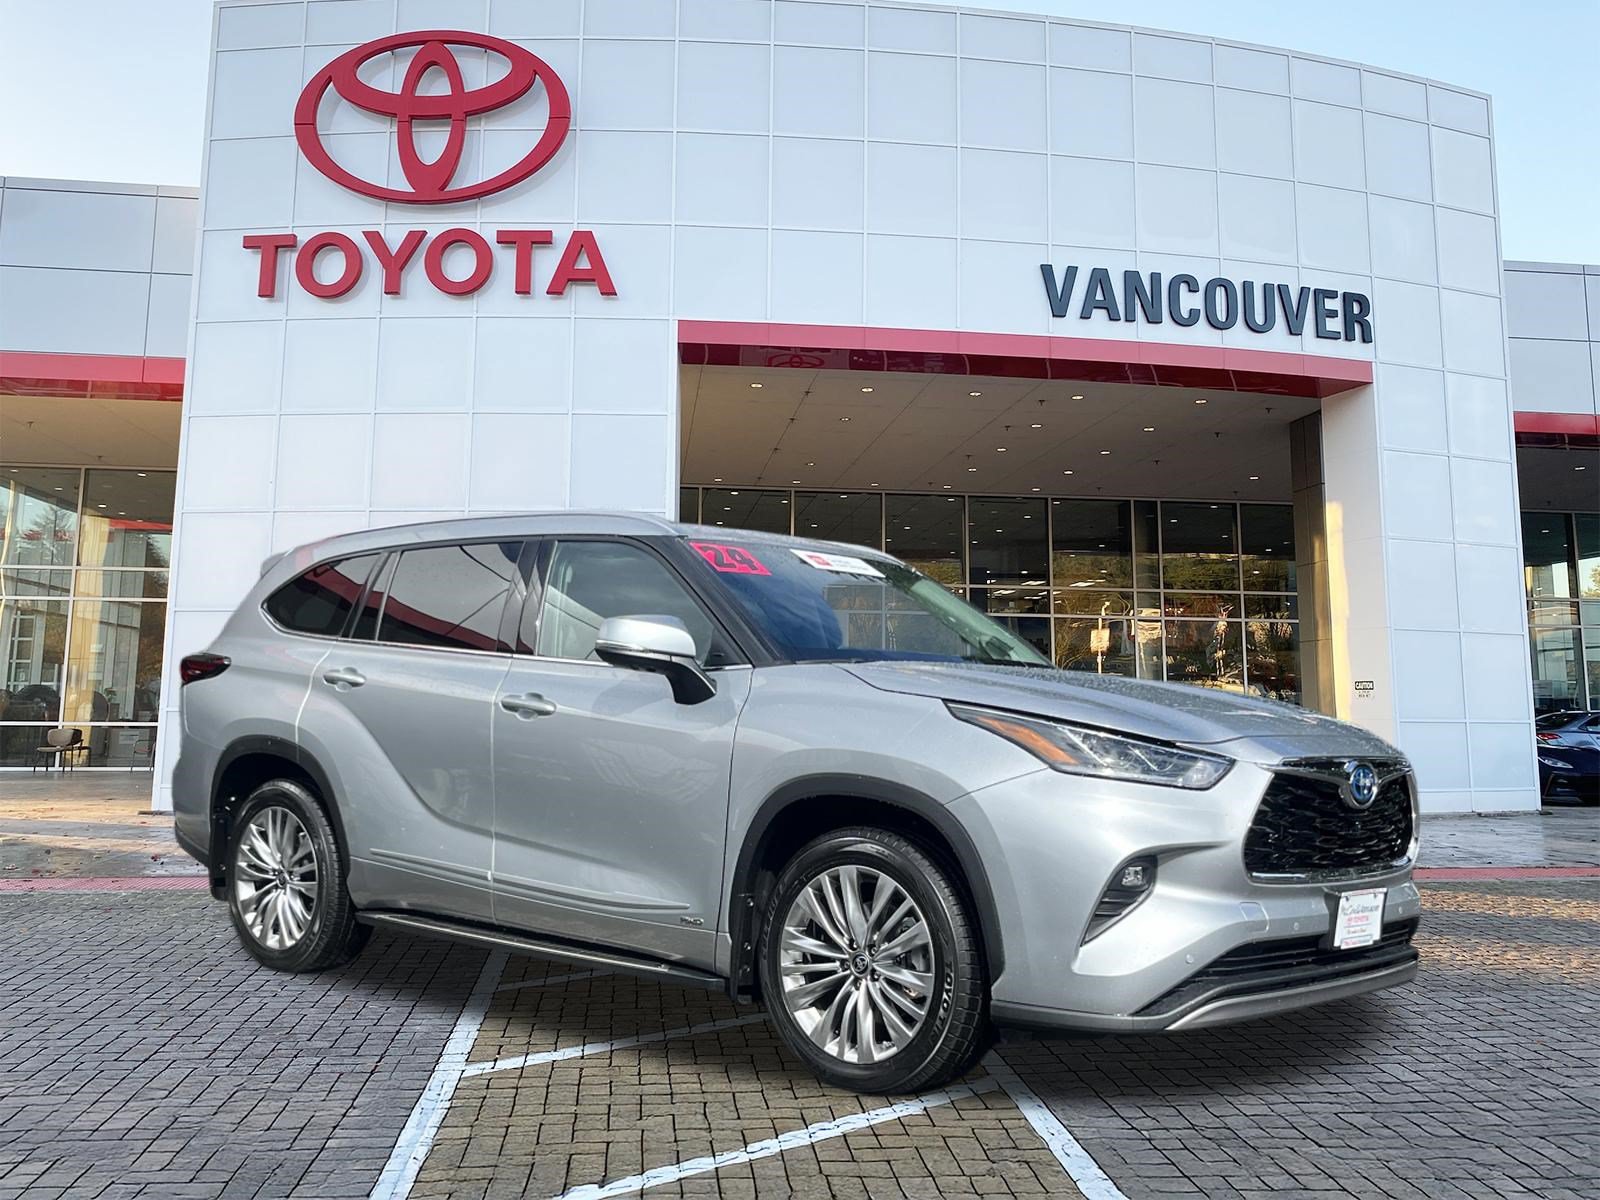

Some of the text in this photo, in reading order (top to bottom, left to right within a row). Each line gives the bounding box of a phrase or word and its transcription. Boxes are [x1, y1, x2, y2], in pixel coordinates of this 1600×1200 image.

[243, 228, 618, 299] TOYOTA
[1040, 263, 1374, 345] VANCOUVER
[700, 545, 758, 571] 24
[940, 960, 955, 1013] TOYO
